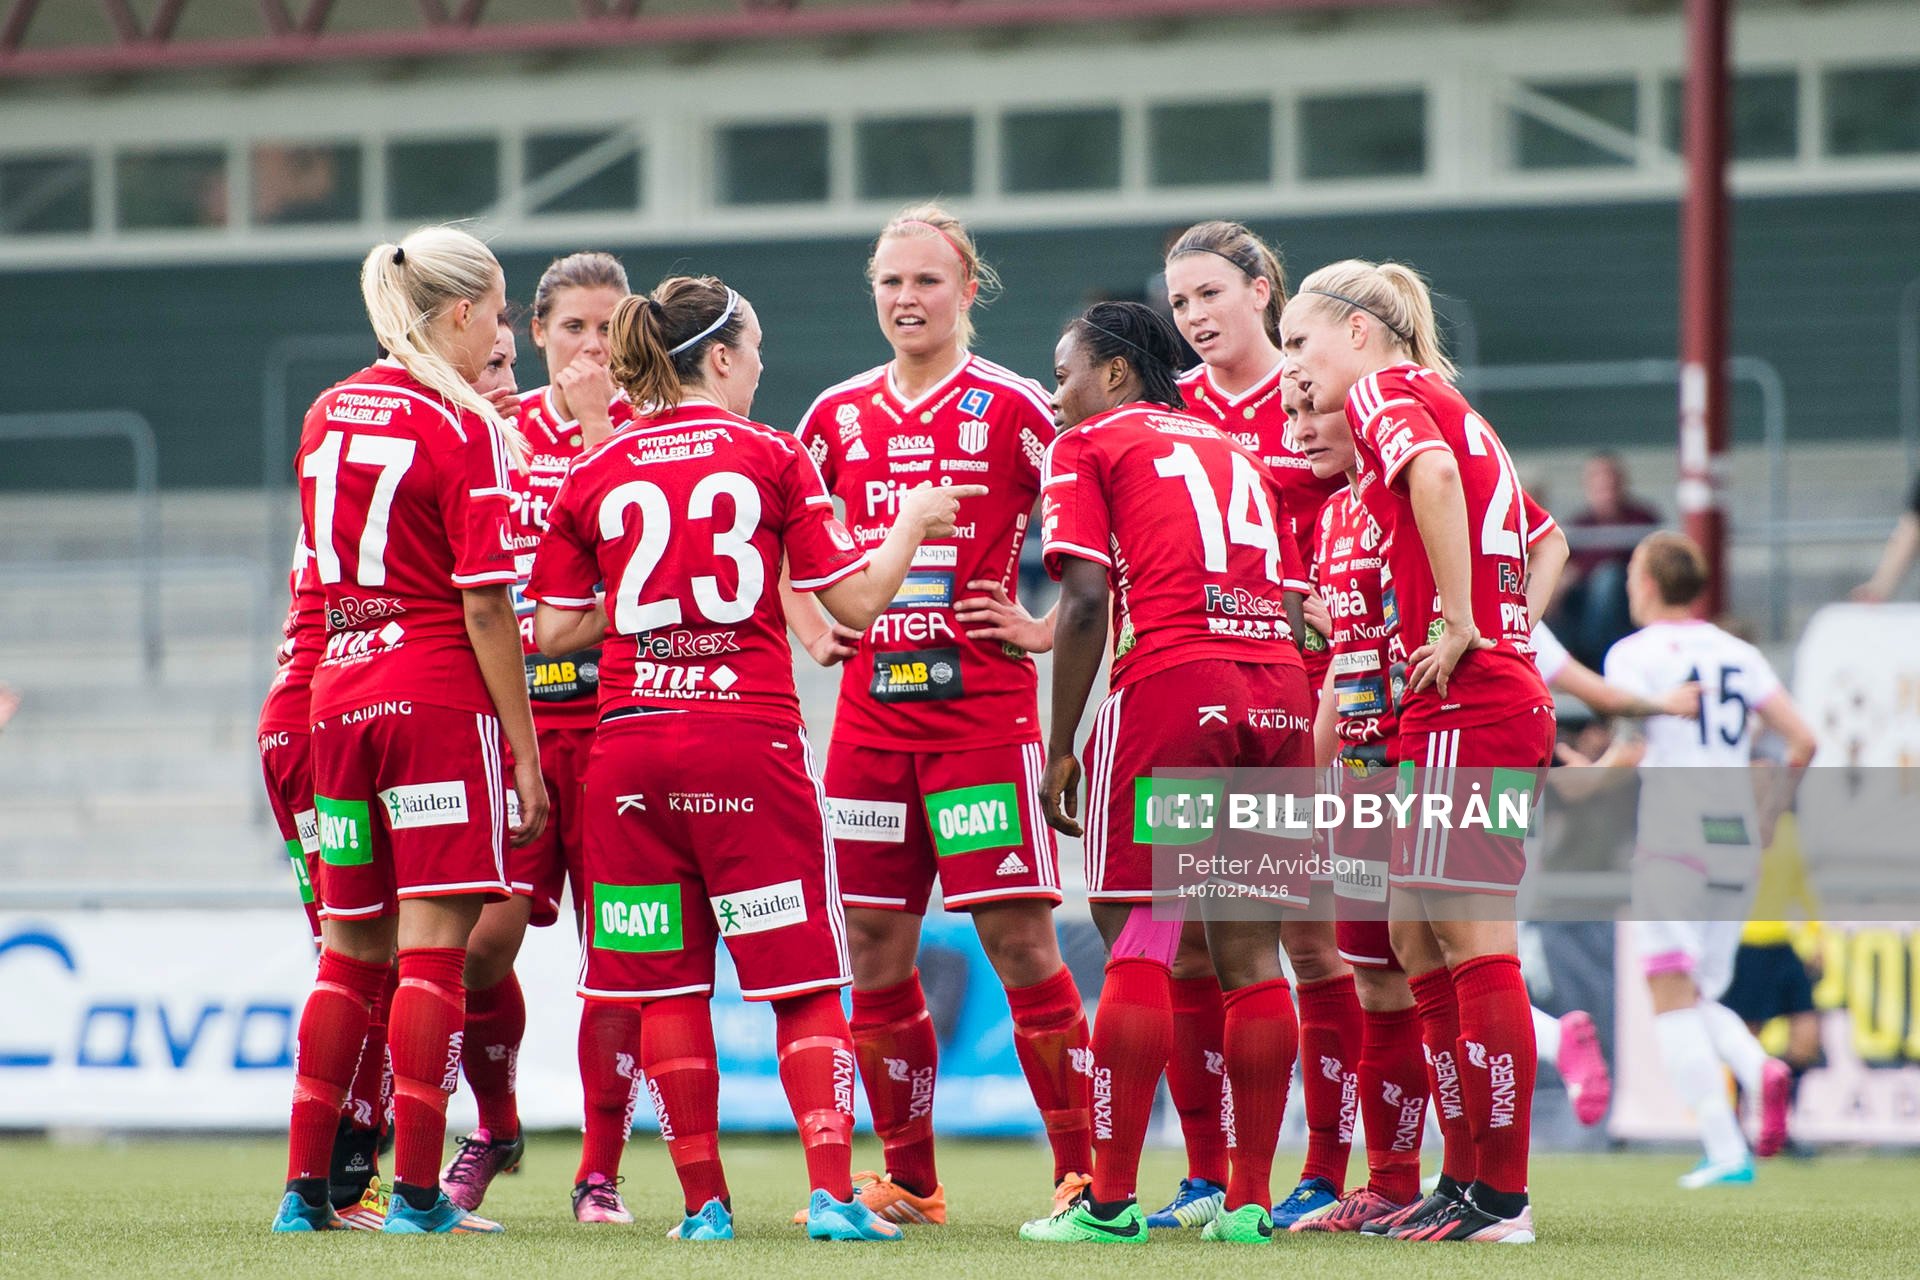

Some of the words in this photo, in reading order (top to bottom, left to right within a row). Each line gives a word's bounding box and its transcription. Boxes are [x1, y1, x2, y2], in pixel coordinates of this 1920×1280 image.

[333, 405, 374, 421] MÅLERI
[374, 410, 392, 422] AB
[336, 392, 401, 409] PITEDALENS
[638, 428, 717, 449] PITEDALENS
[641, 444, 691, 461] MÅLERI
[694, 442, 714, 456] AB
[888, 435, 935, 449] SÄKRA
[302, 430, 417, 587] 17
[1153, 441, 1283, 586] 14
[598, 471, 765, 636] 23
[635, 630, 741, 659] FeRex
[533, 662, 577, 686] JIAB
[888, 662, 929, 684] JIAB
[342, 701, 413, 726] KAIDING
[1687, 666, 1748, 747] 15
[1248, 713, 1310, 733] KAIDING
[668, 798, 754, 813] KAIDING
[938, 800, 1008, 839] OCAY!
[996, 865, 1029, 876] adidas
[602, 901, 670, 937] OCAY!
[1433, 1051, 1464, 1120] WIXNERS
[1490, 1053, 1516, 1128] WIXNERS
[1094, 1067, 1112, 1139] WIXNERS
[1339, 1072, 1358, 1144] WIXNERS
